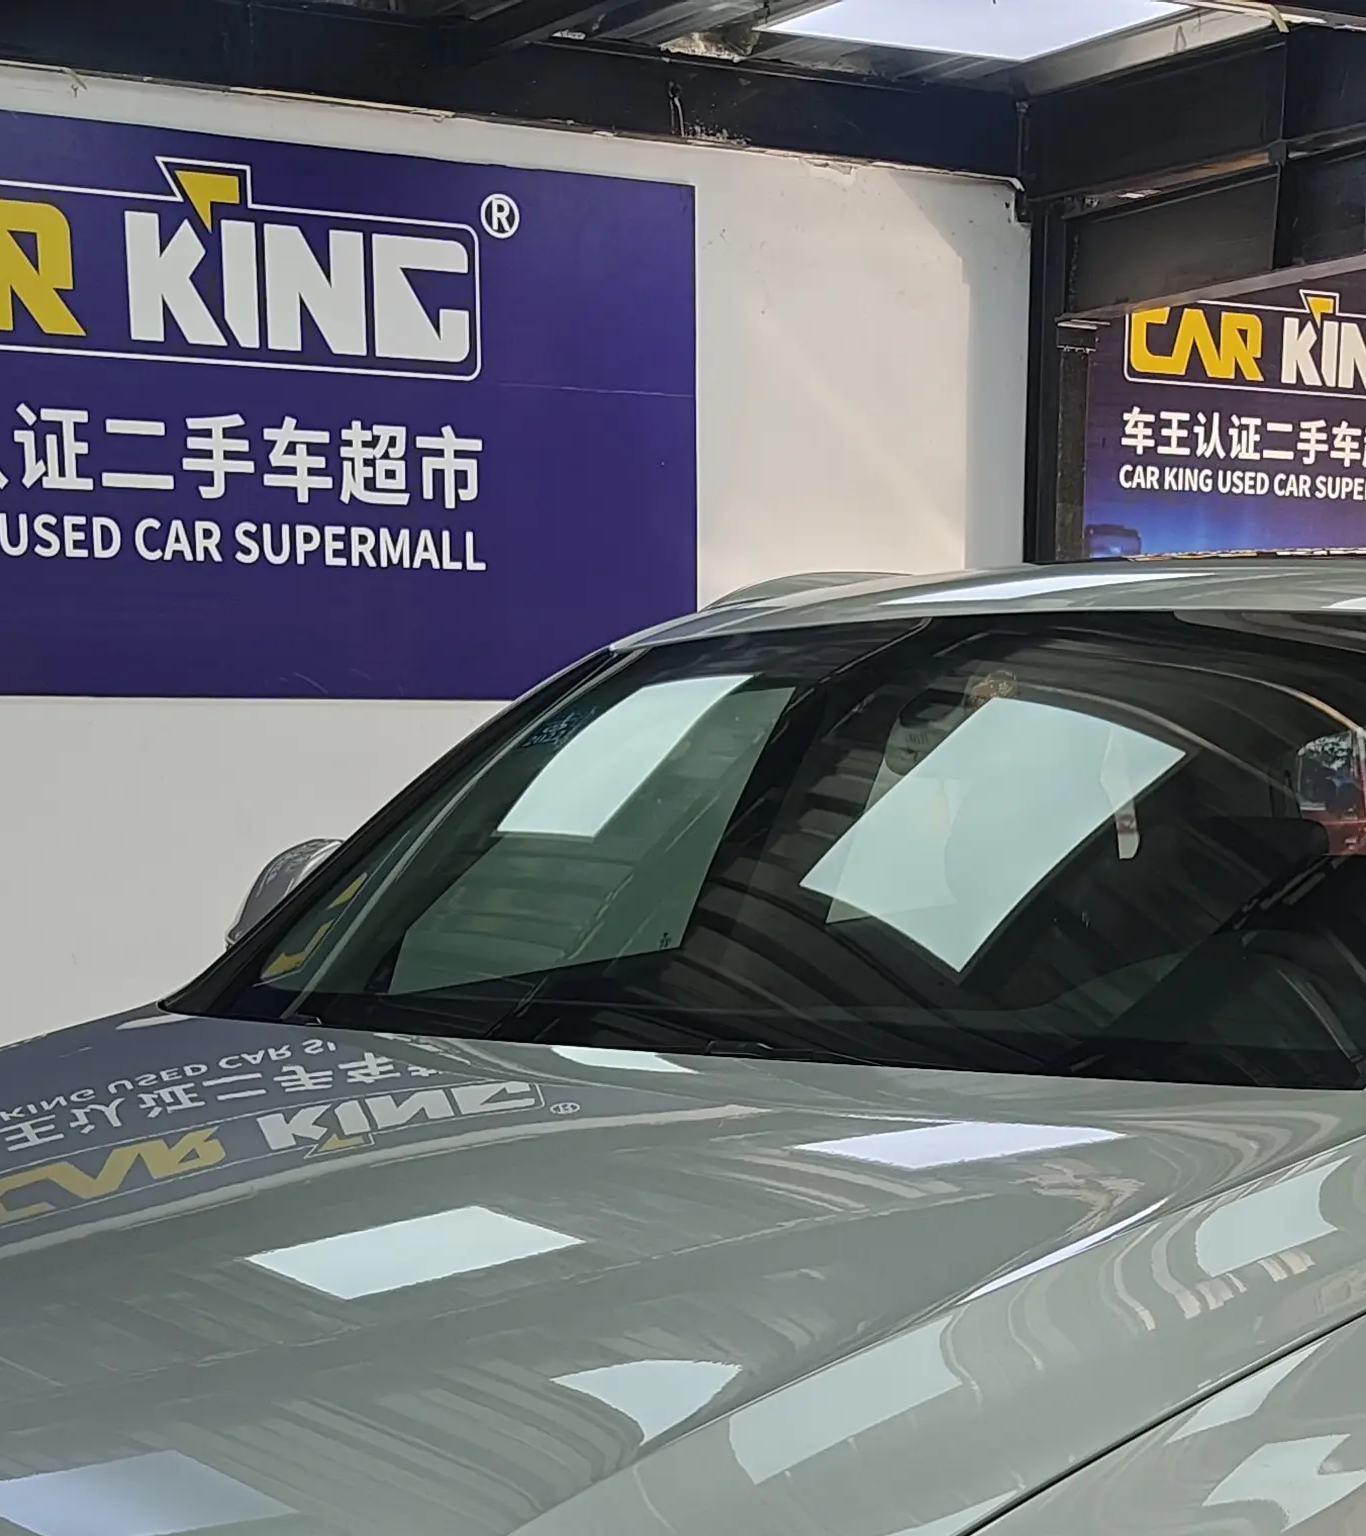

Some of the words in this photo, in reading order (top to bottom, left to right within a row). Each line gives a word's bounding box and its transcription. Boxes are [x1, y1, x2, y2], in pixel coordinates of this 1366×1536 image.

[124, 170, 470, 362] KING
[1131, 306, 1264, 382] CAR
[1119, 464, 1158, 489] CAR
[1164, 467, 1213, 492] KING
[1217, 470, 1269, 496] USED
[1273, 472, 1310, 498] CAR
[134, 518, 222, 563] CAR
[235, 521, 487, 573] SUPERMALL
